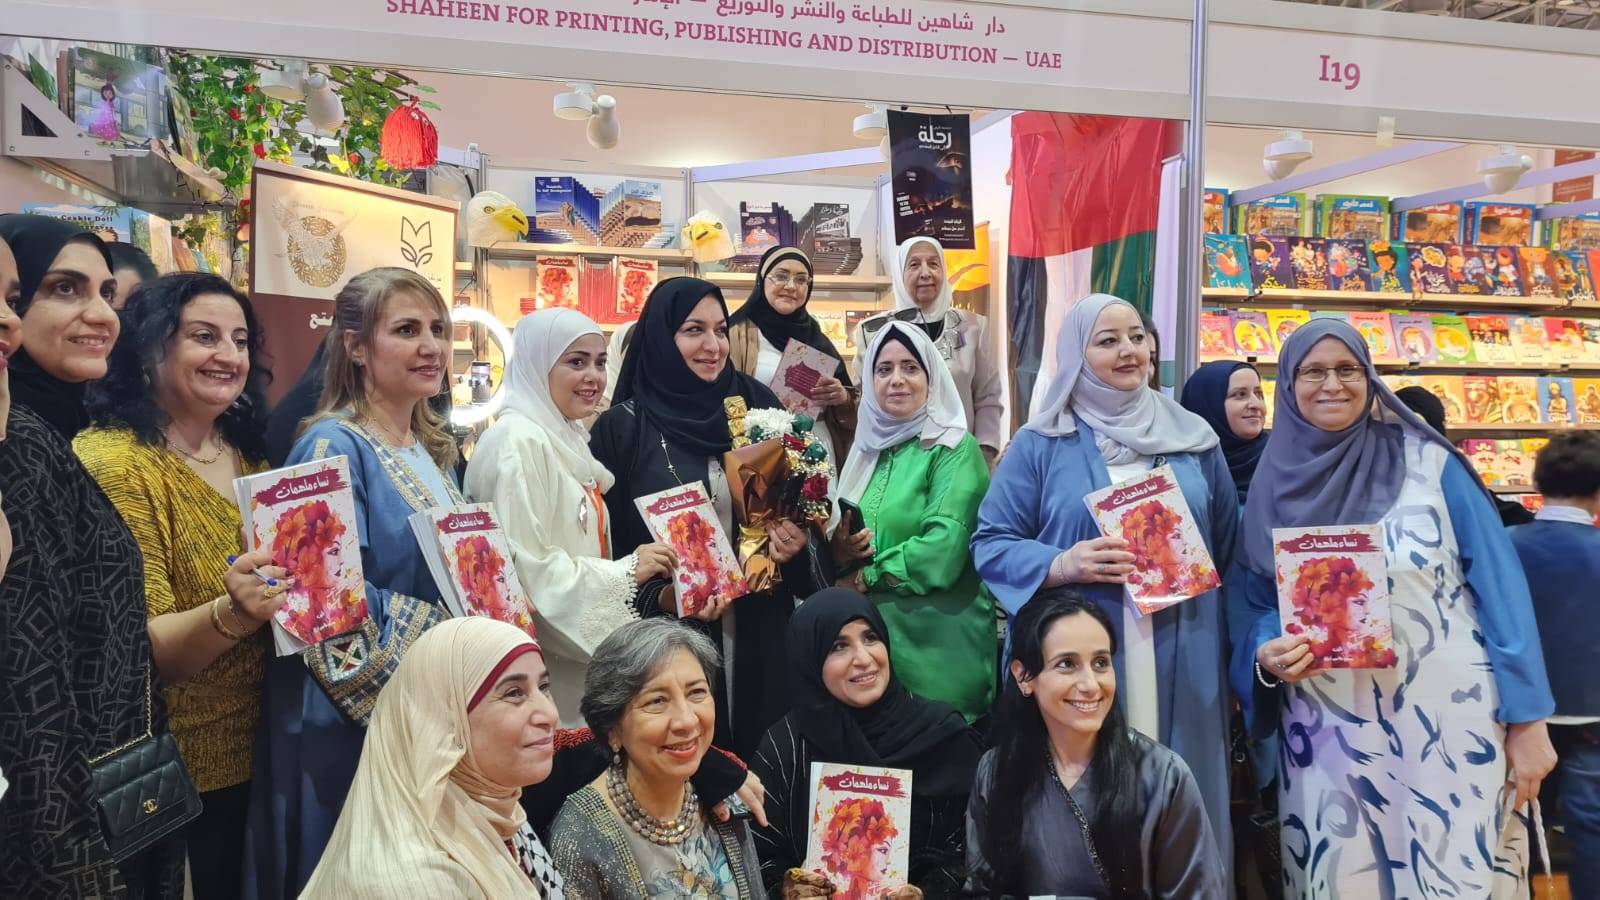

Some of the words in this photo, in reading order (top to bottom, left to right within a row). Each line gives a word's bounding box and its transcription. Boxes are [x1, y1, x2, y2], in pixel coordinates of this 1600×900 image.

[790, 0, 846, 25] والنشر
[851, 4, 912, 27] للطباعة
[917, 12, 975, 33] شاهين
[386, 0, 501, 22] SHAHEEN
[506, 5, 550, 27] FOR
[555, 10, 669, 40] PRINTING,
[674, 20, 803, 49] PUBLISHING
[807, 32, 854, 53] AND
[858, 36, 998, 64] DISTRIBUTION
[1025, 51, 1063, 70] UAE
[986, 17, 1006, 36] دار
[1319, 54, 1361, 91] I19
[918, 125, 952, 149] رحلة
